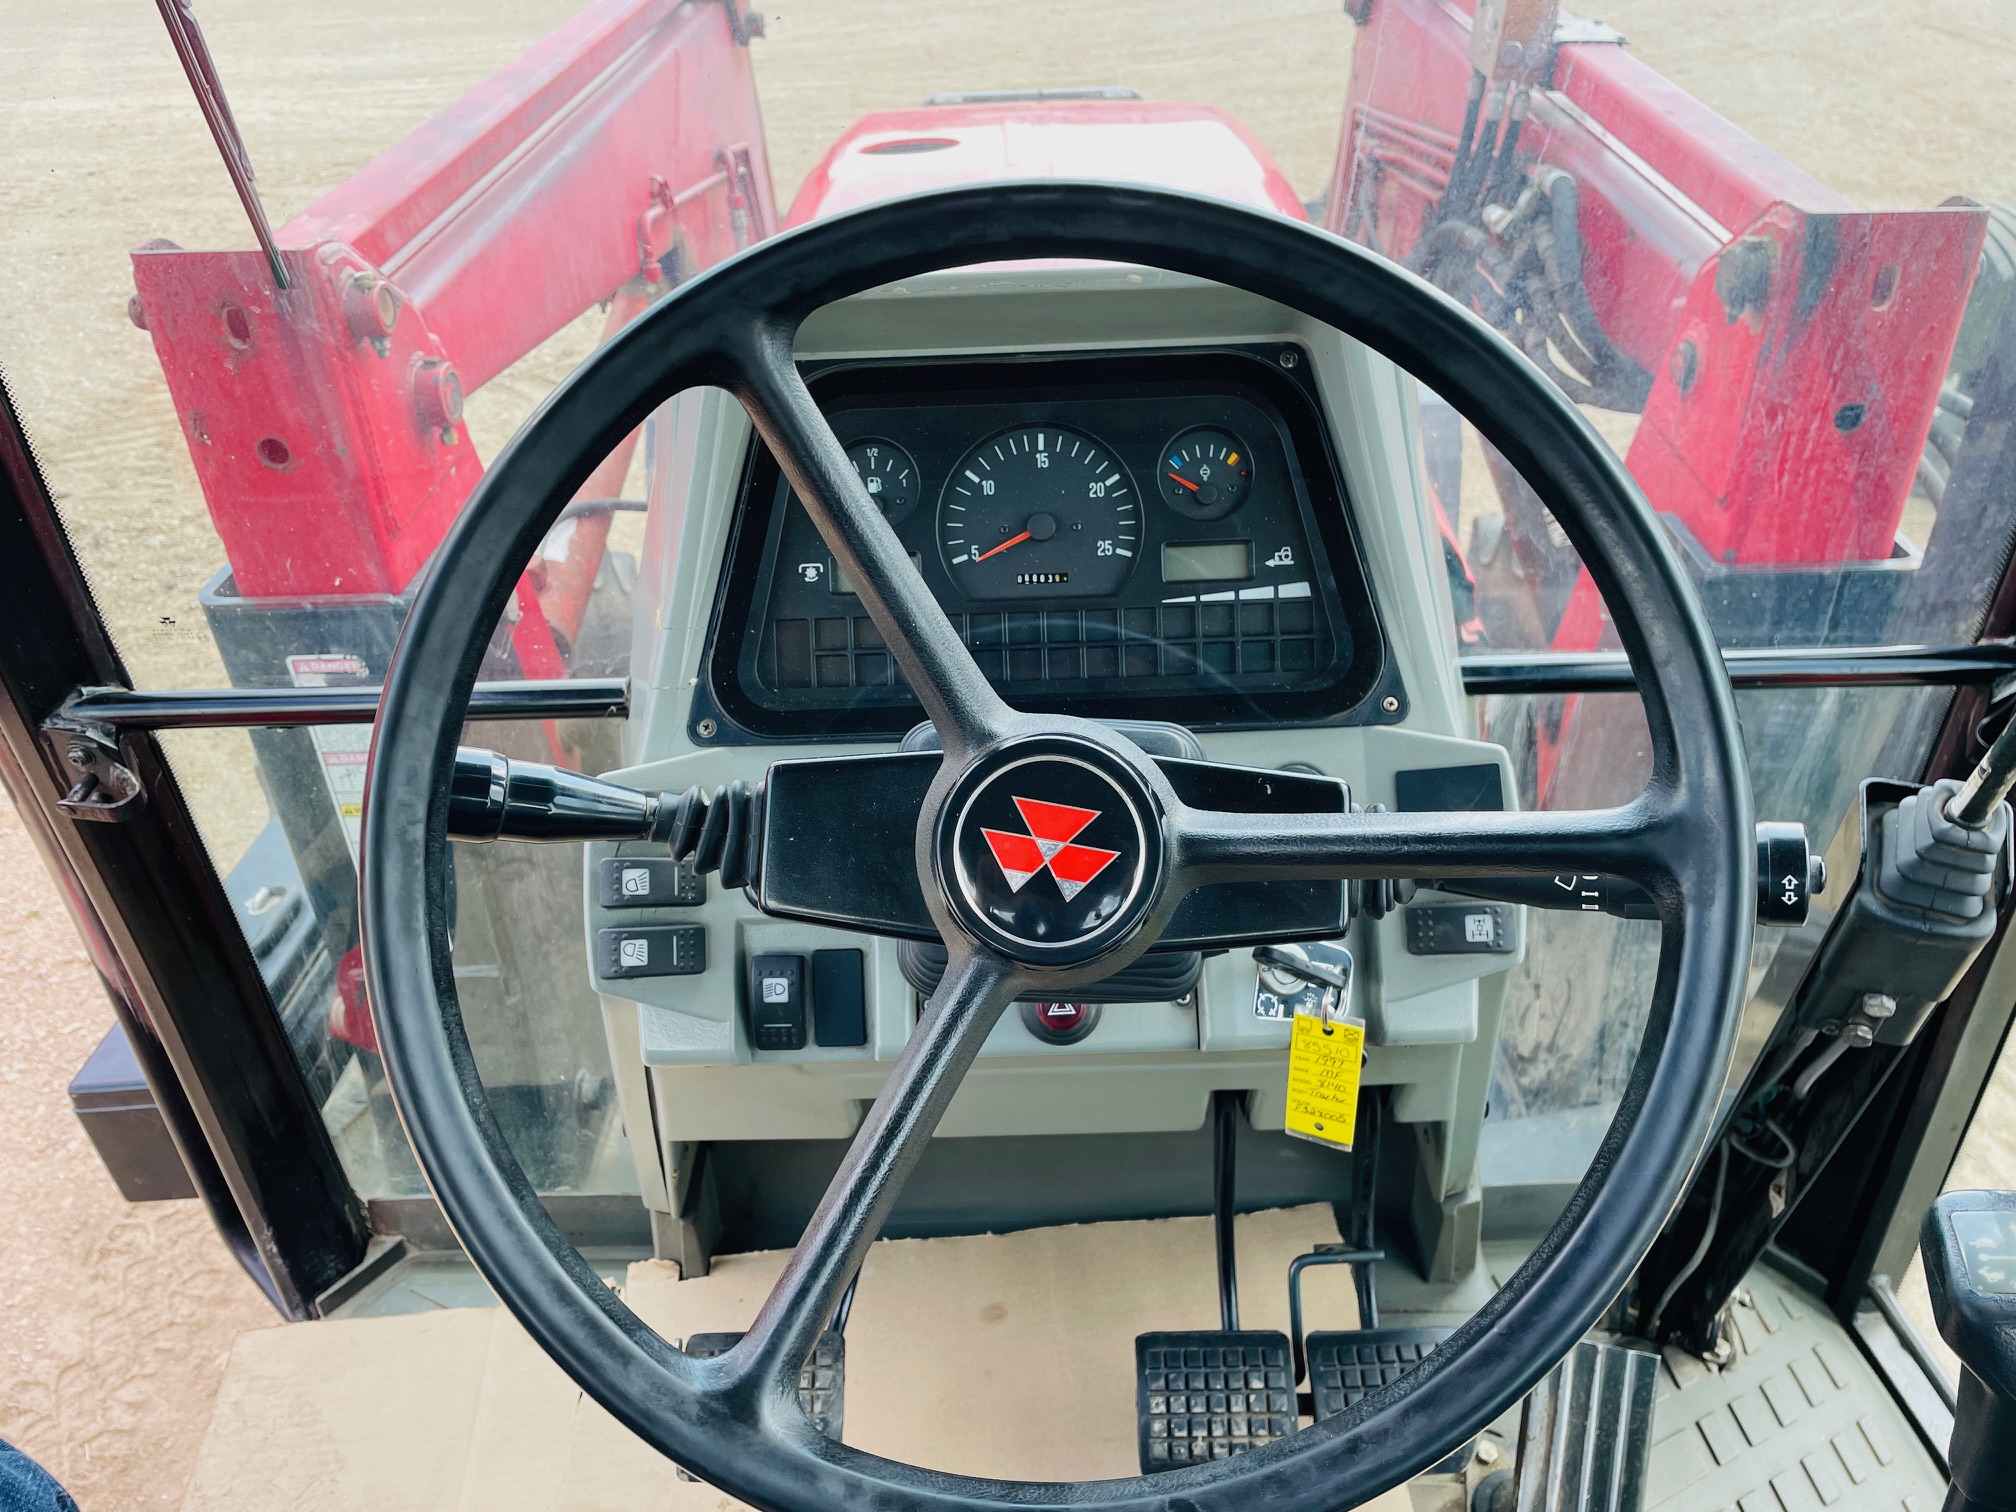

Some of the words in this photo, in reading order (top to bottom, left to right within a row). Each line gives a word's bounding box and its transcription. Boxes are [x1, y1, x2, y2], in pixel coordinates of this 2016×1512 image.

[866, 447, 879, 457] 1/2
[1035, 453, 1049, 468] 15
[981, 480, 995, 495] 10
[1089, 482, 1105, 497] 20
[970, 545, 980, 560] 5
[1096, 540, 1113, 556] 25
[1302, 1038, 1350, 1058] 85510
[1320, 1069, 1344, 1079] MF
